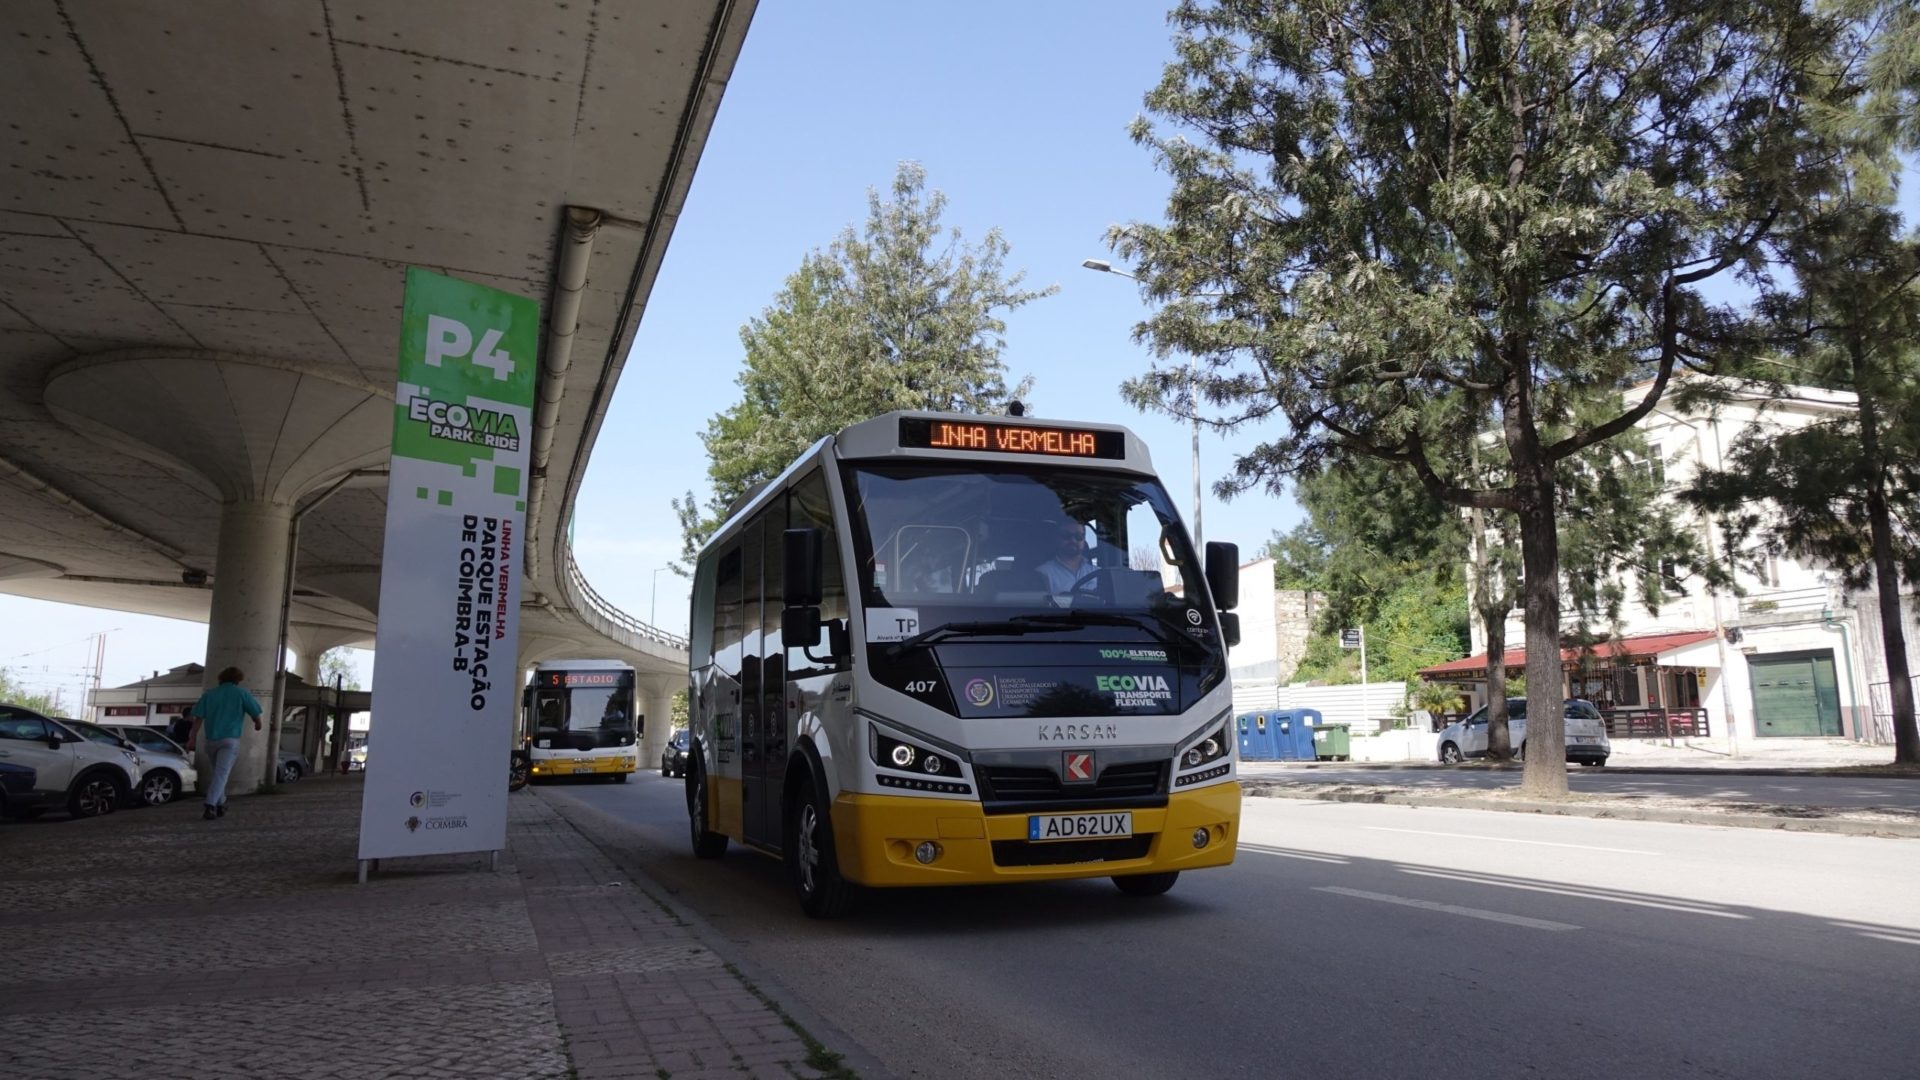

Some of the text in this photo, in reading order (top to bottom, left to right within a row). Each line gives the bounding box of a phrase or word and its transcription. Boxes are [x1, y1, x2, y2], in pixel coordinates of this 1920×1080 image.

[425, 314, 515, 381] P4
[409, 395, 519, 438] ECOVIA
[430, 424, 519, 451] PARK&RIDE
[996, 429, 1095, 454] VERMELHA
[495, 519, 512, 640] LINHA VERMELHA
[453, 514, 478, 672] DE COIMBRA-B
[468, 517, 497, 711] PARQUE ESTAÇÃO
[895, 618, 917, 633] TP
[552, 674, 614, 685] 5 ESTADIO
[905, 680, 937, 693] 407
[1096, 675, 1170, 691] ECOVIA
[1113, 691, 1171, 699] TRANSPORTE
[1038, 724, 1117, 741] KARSAN
[425, 820, 468, 829] COIMBRA
